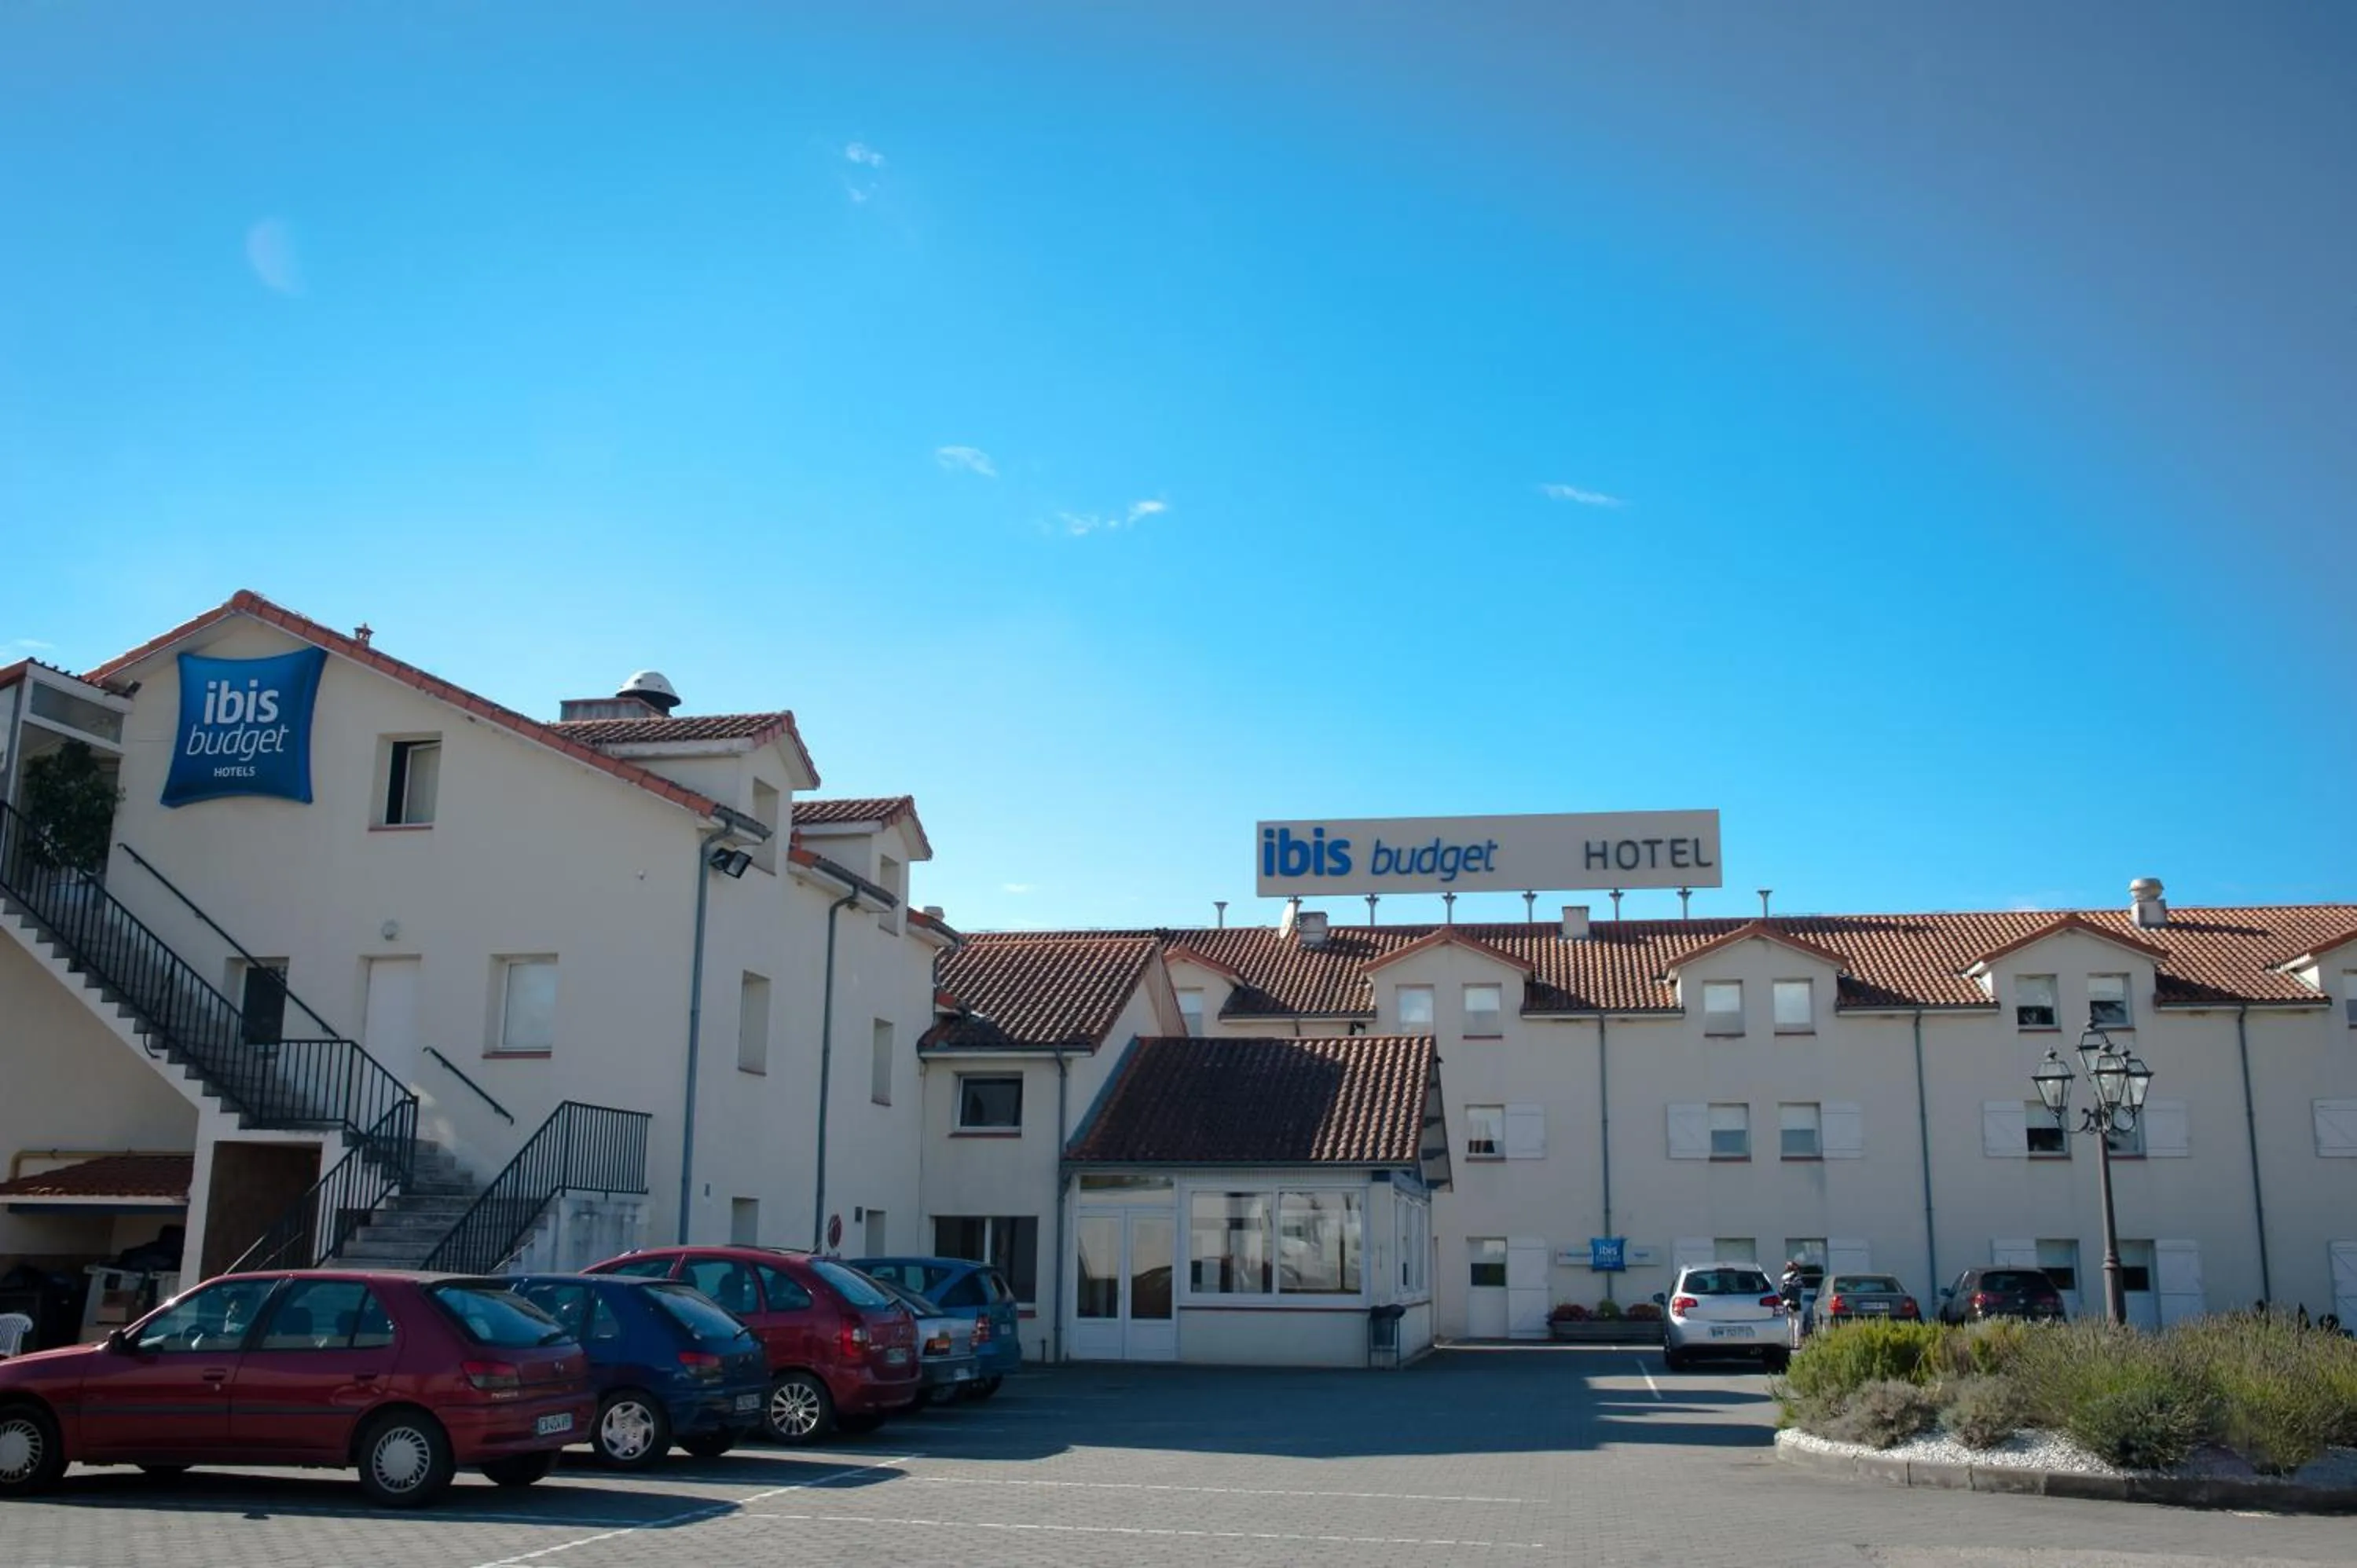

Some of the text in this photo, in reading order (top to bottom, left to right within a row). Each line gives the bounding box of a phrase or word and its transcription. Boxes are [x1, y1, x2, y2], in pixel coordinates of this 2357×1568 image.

[203, 679, 280, 725] ibis
[185, 723, 290, 761] budget
[213, 766, 256, 778] HOTELS
[1263, 827, 1714, 882] ibis budget HOTEL
